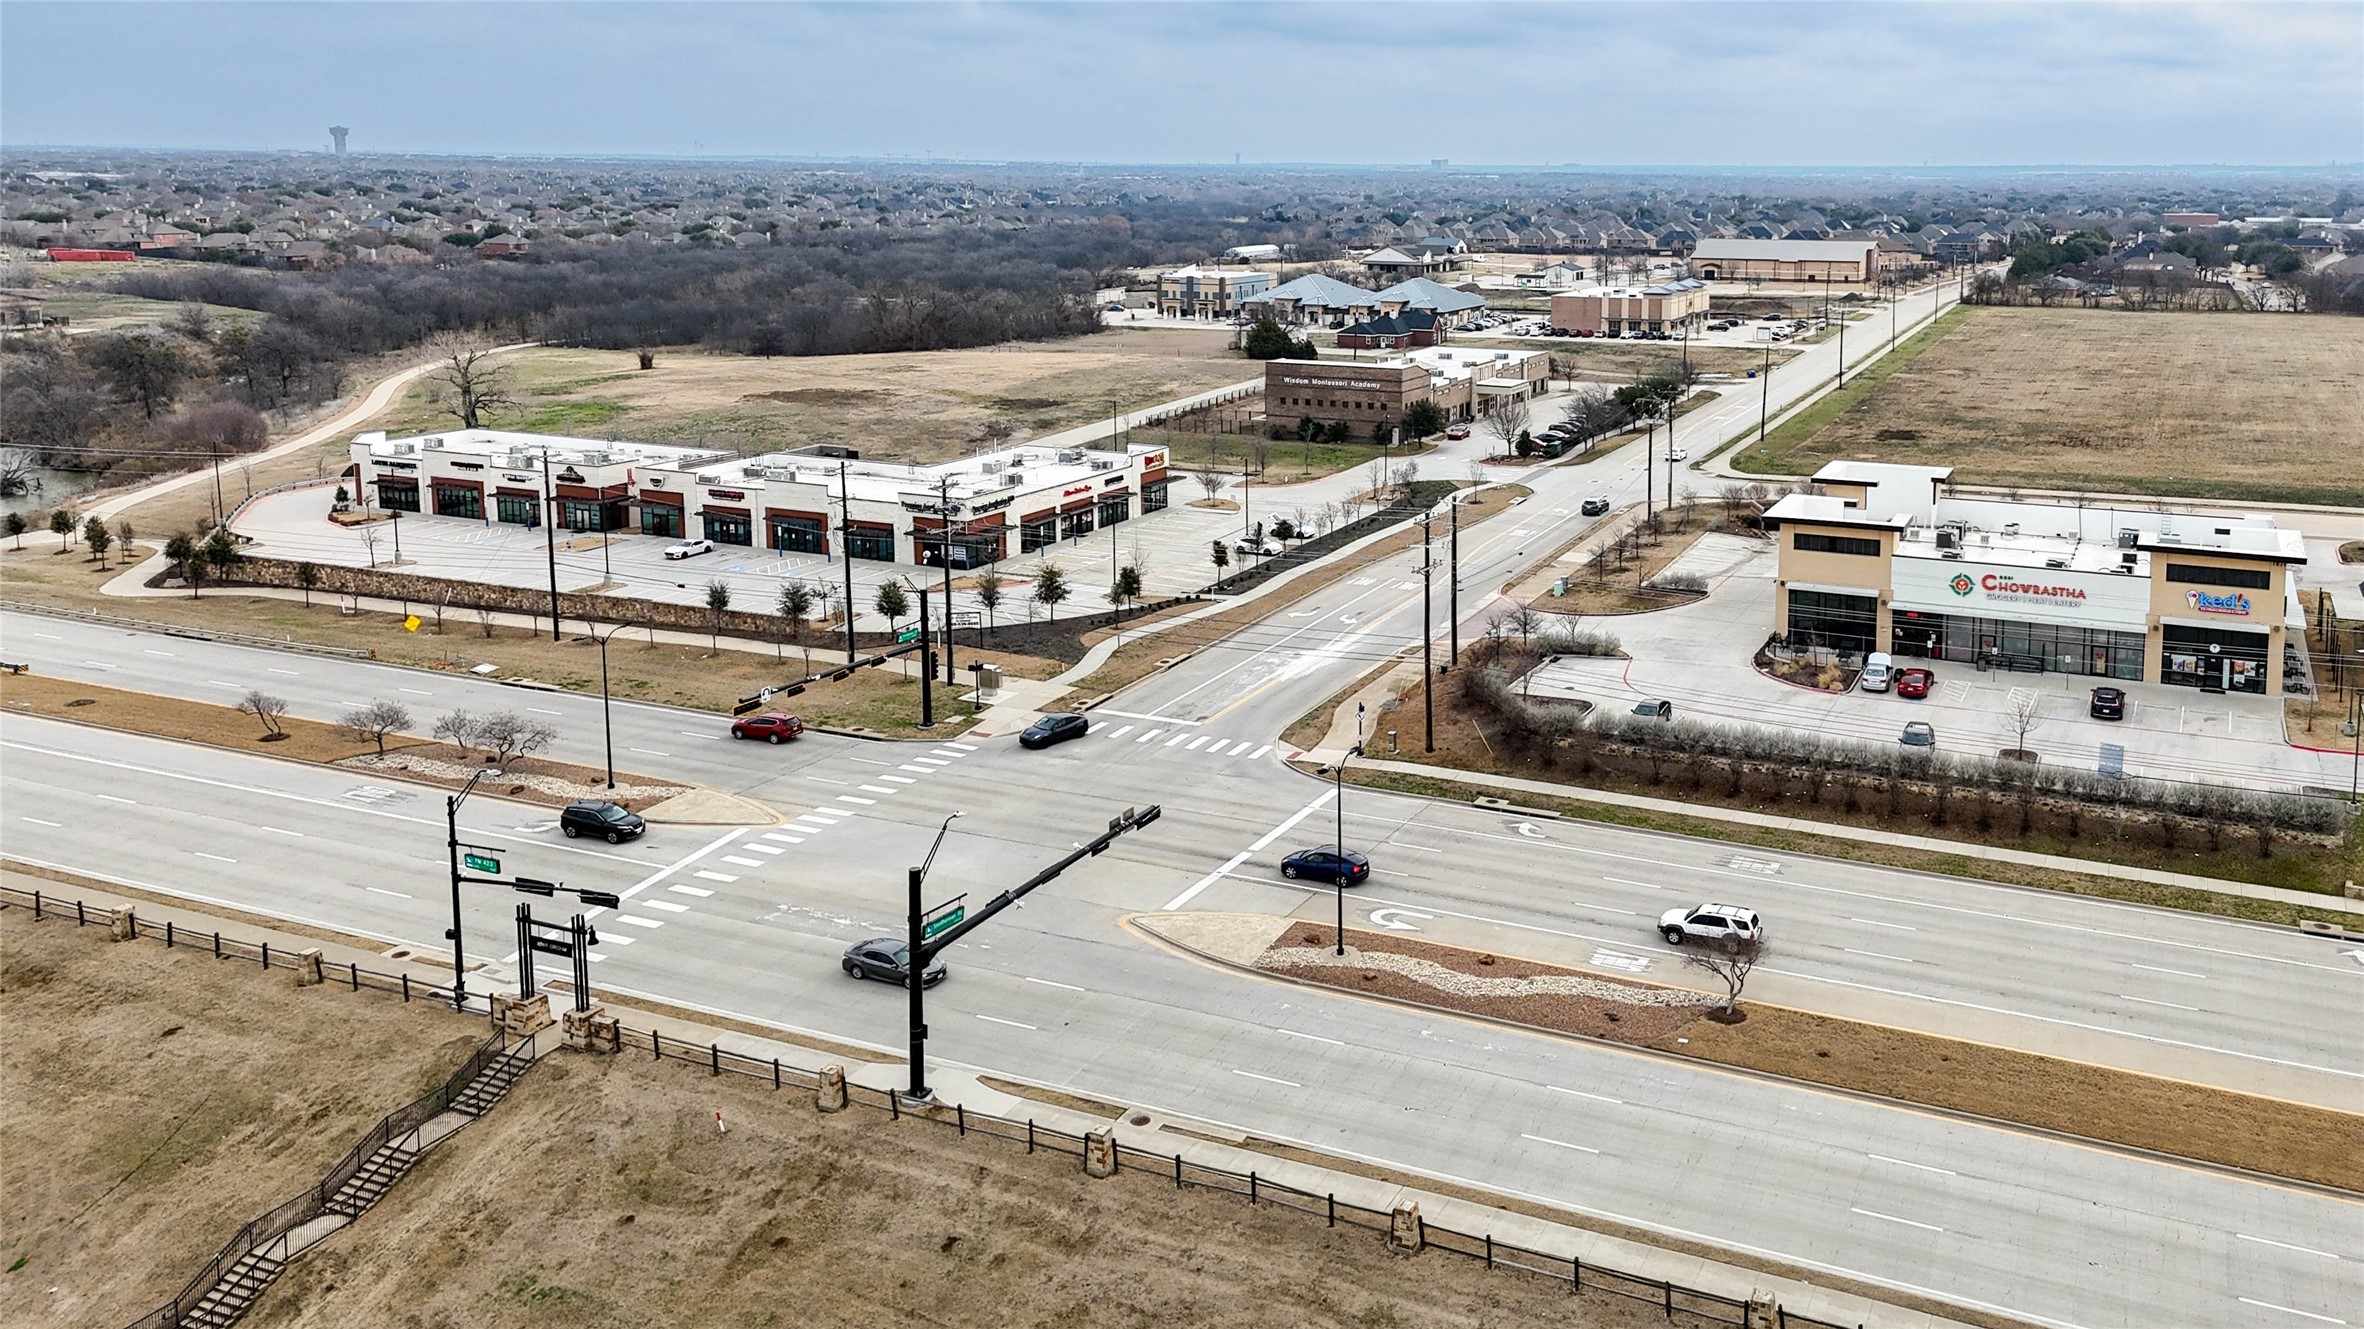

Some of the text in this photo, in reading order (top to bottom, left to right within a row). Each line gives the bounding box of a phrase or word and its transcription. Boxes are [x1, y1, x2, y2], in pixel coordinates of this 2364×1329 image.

[1283, 376, 1381, 391] Wisdom Montessori Academy
[1981, 574, 2087, 600] CHOWRASTHA
